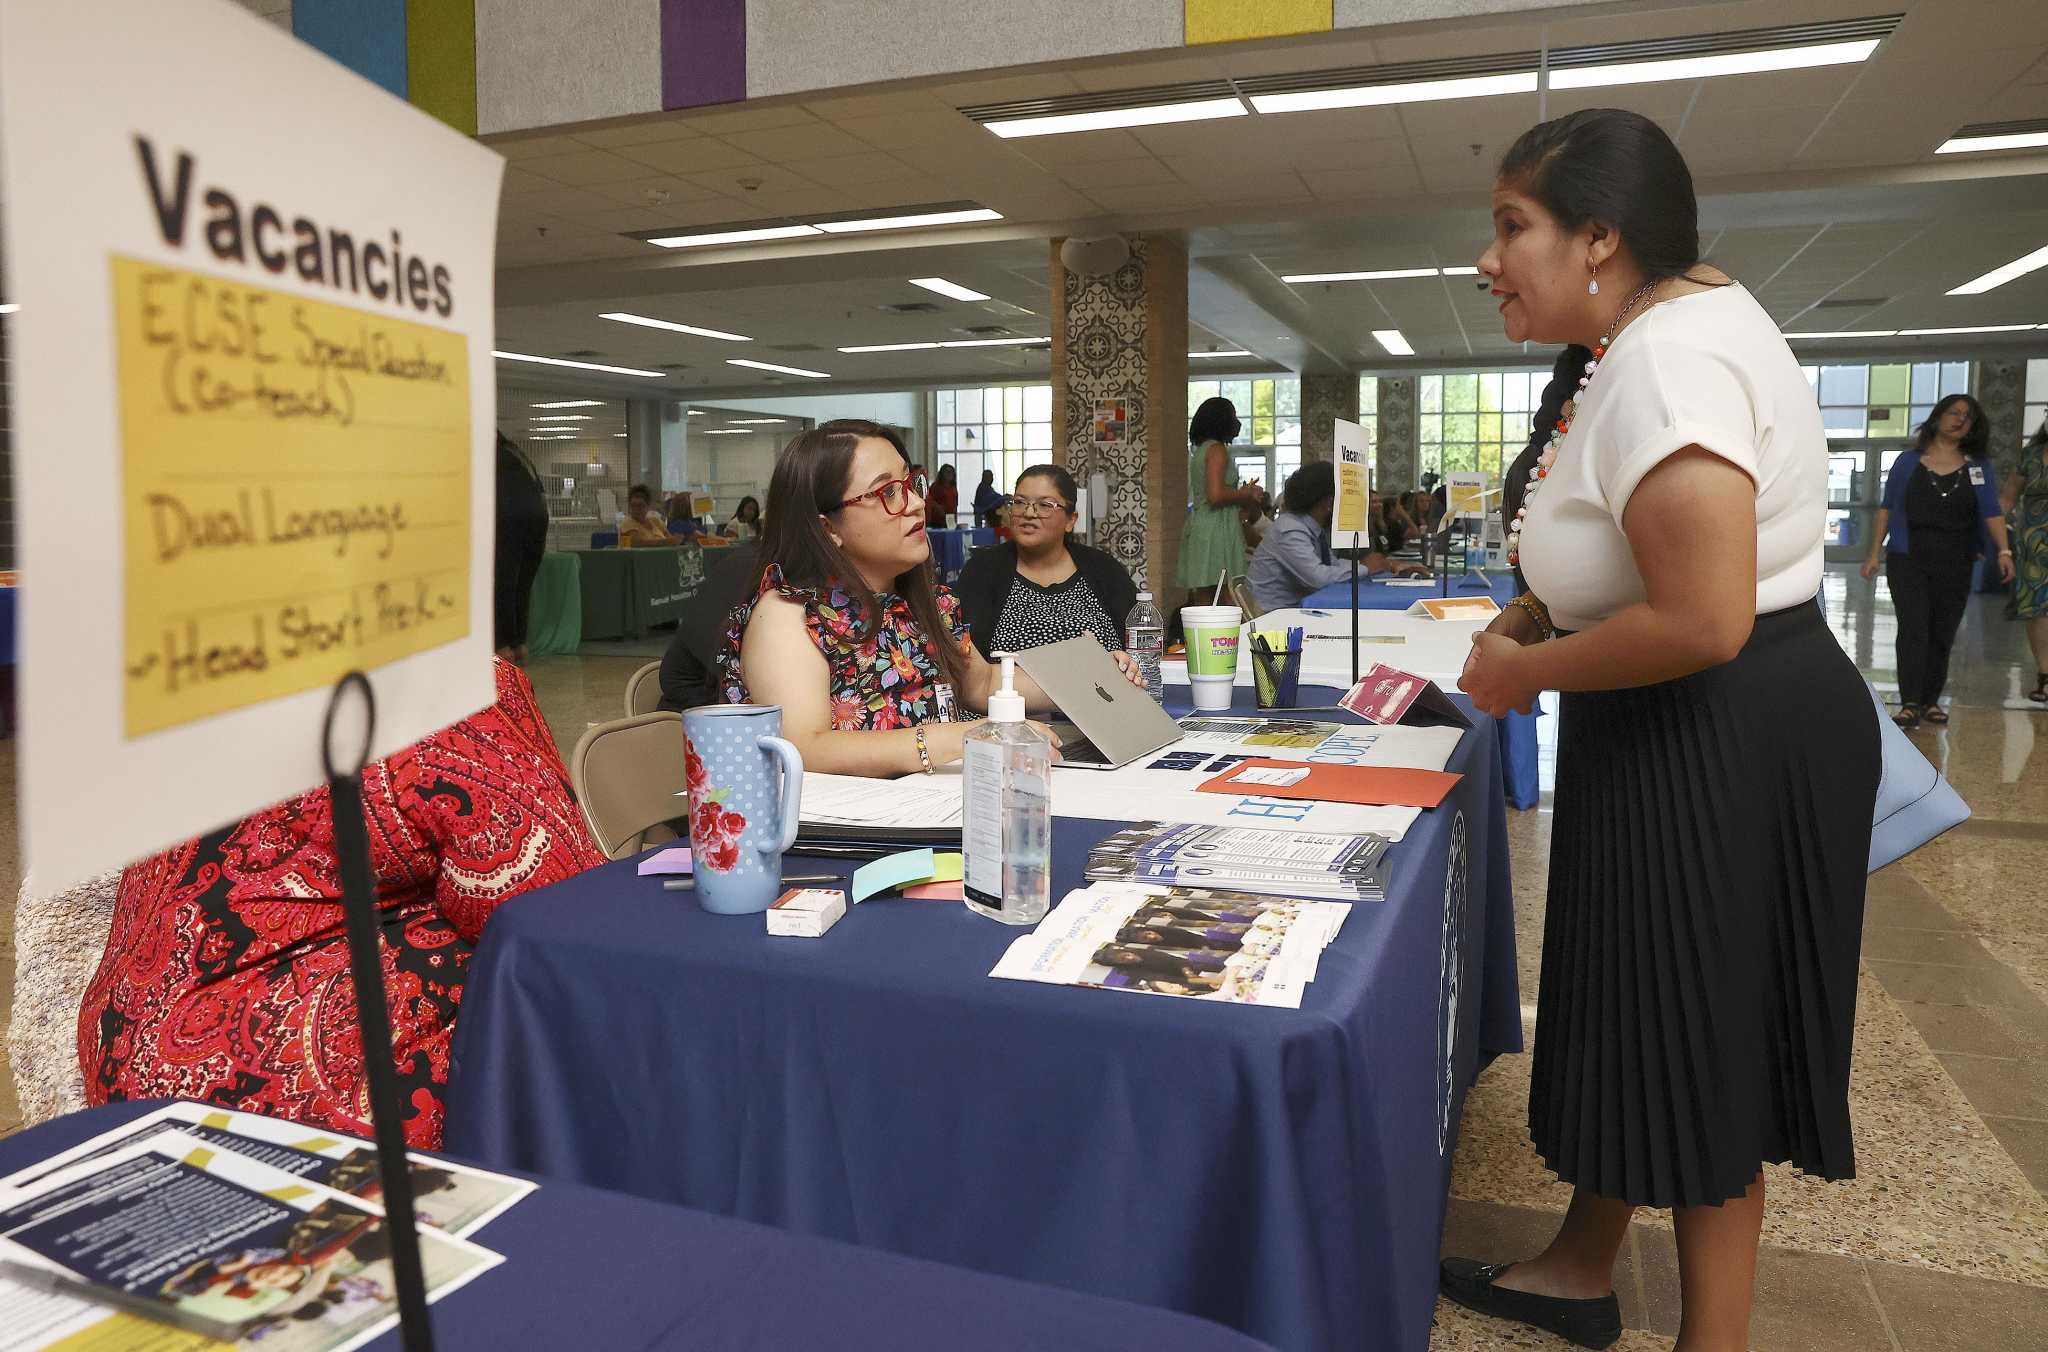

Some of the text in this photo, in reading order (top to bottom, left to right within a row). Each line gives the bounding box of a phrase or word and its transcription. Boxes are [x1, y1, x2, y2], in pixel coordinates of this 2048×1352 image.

[132, 128, 455, 318] Vacancies
[140, 270, 280, 363] ECSE
[145, 488, 407, 564] Dual Language
[162, 614, 269, 693] Head
[278, 591, 363, 659] Start
